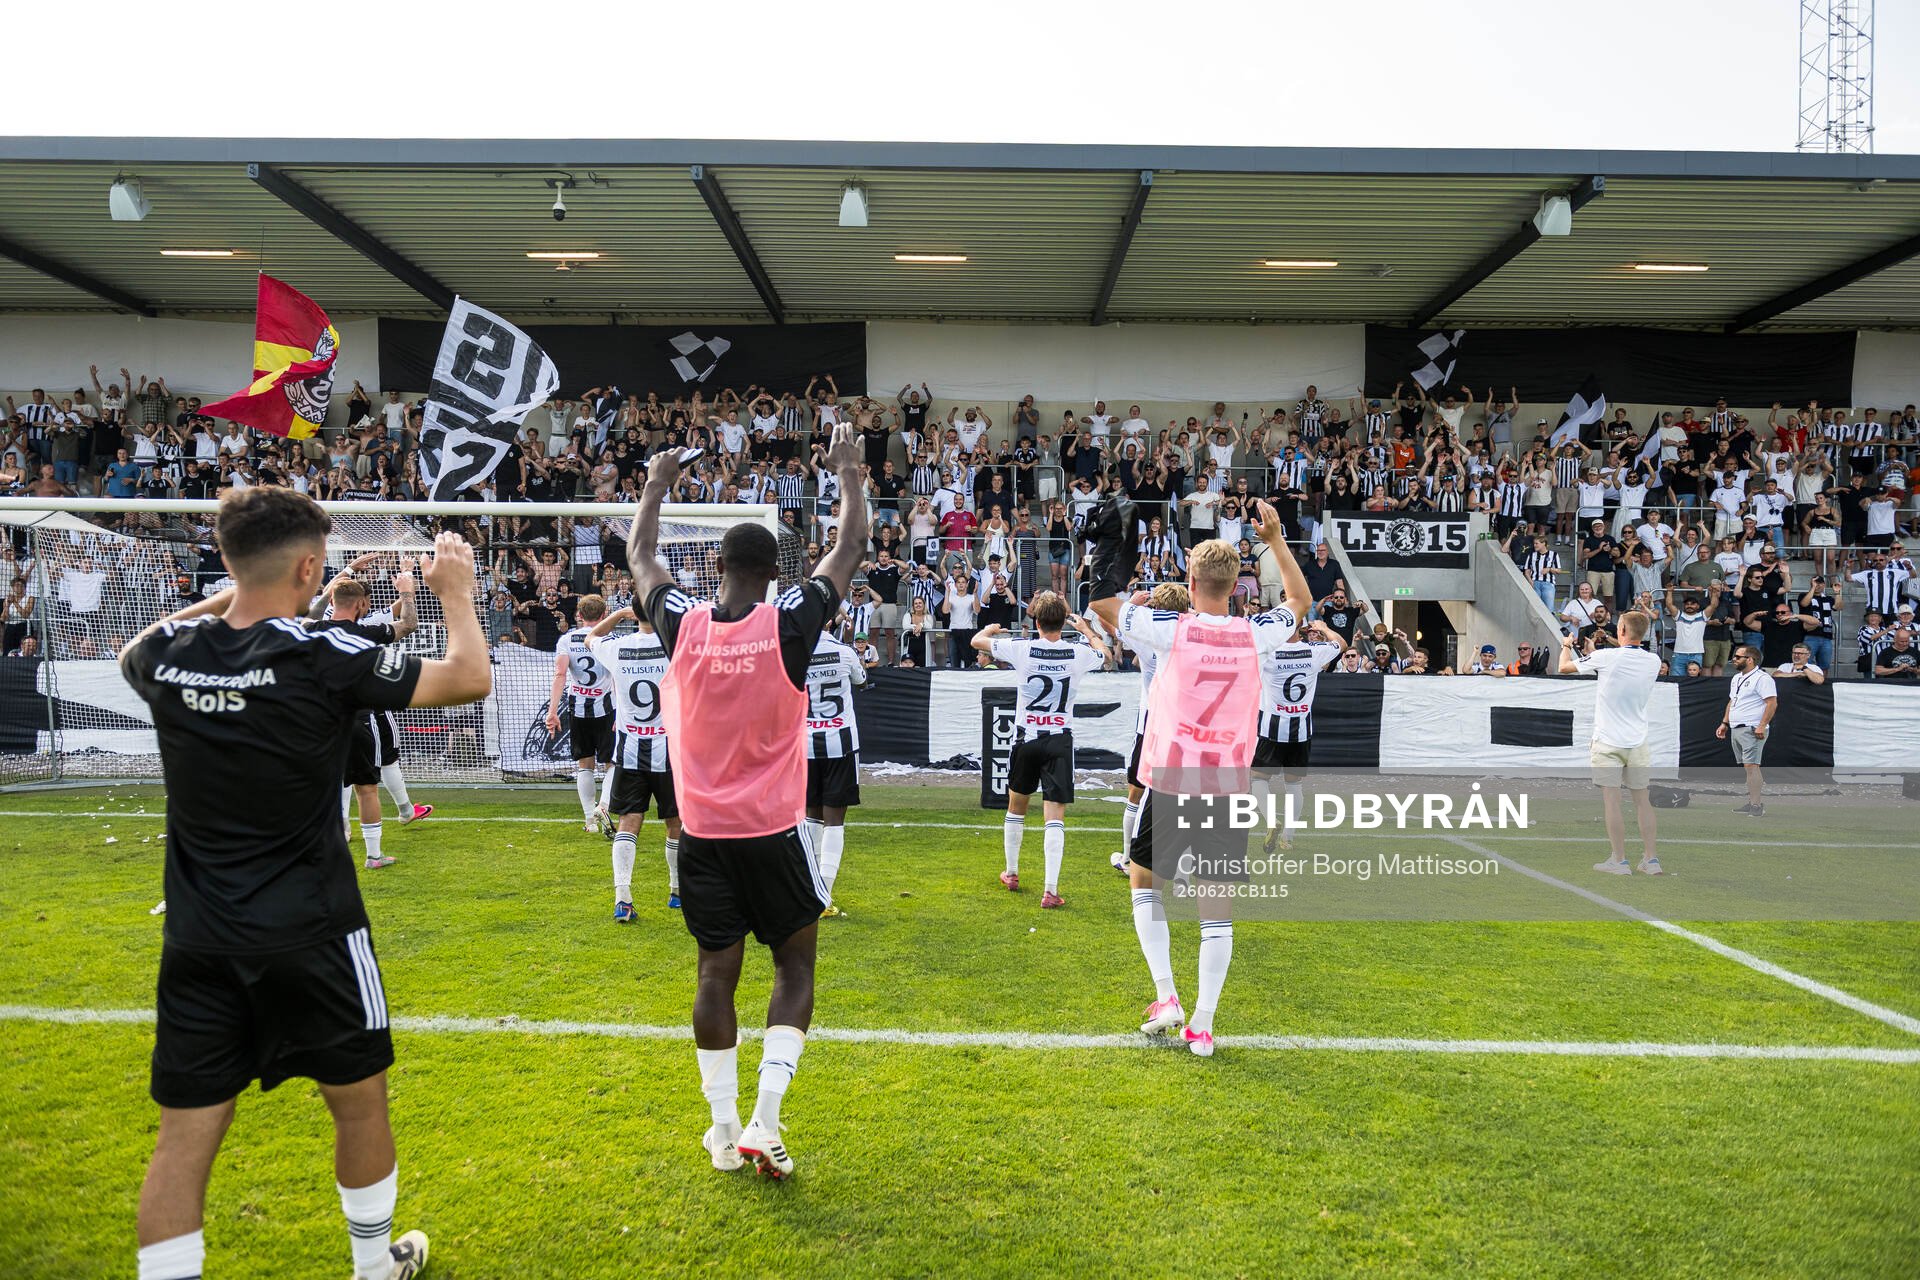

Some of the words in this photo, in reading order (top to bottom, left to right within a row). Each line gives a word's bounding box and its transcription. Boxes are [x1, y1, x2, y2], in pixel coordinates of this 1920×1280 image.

[1337, 522, 1385, 550] LF
[1428, 524, 1466, 551] 15
[689, 638, 777, 657] LANDSKRONA
[577, 656, 598, 686] 3
[710, 657, 756, 674] BoIS
[1277, 662, 1312, 670] KARLSSON
[182, 688, 247, 713] BoIS
[572, 685, 603, 696] PULS
[628, 679, 660, 722] 9
[1025, 674, 1071, 714] 21
[1194, 671, 1240, 727] 7
[1282, 673, 1307, 703] 6
[1027, 714, 1065, 726] PULS
[1276, 704, 1309, 714] PULS
[1177, 722, 1236, 746] PULS
